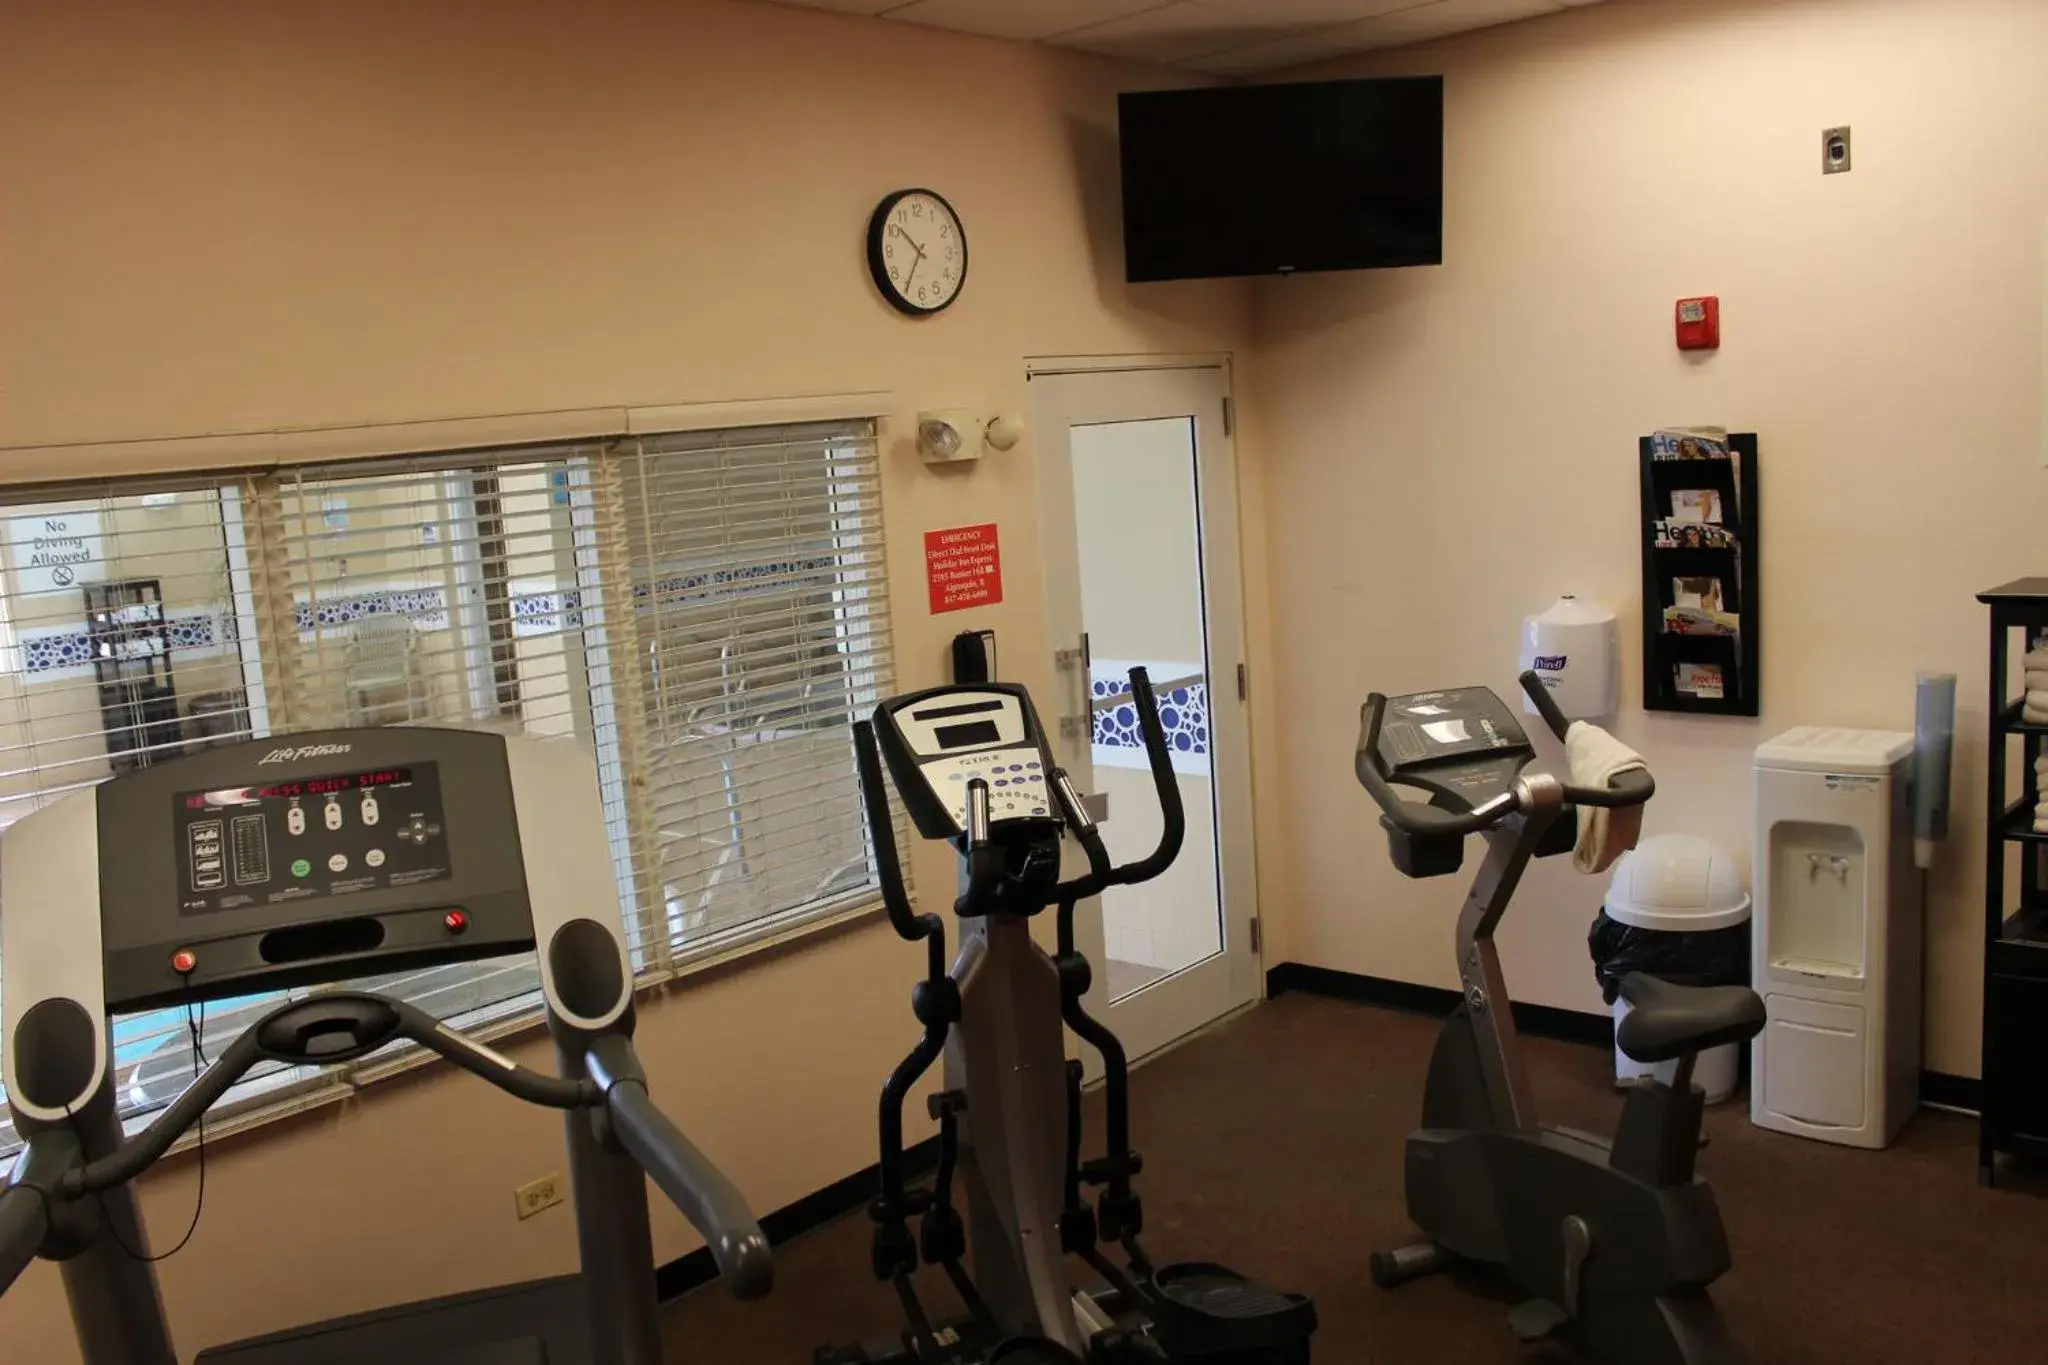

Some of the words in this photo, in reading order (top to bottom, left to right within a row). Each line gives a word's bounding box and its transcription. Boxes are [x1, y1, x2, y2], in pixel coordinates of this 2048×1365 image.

[899, 210, 908, 223] 11
[912, 203, 922, 217] 12
[888, 223, 901, 238] 10
[941, 224, 949, 239] 2
[886, 243, 893, 258] 9
[946, 246, 953, 260] 3
[890, 265, 900, 280] 8
[943, 266, 951, 280] 4
[918, 286, 926, 301] 6
[932, 281, 941, 295] 5
[45, 520, 66, 532] No
[33, 535, 82, 550] Diving
[941, 530, 981, 544] EMERGENCY
[31, 548, 90, 568] Allowed
